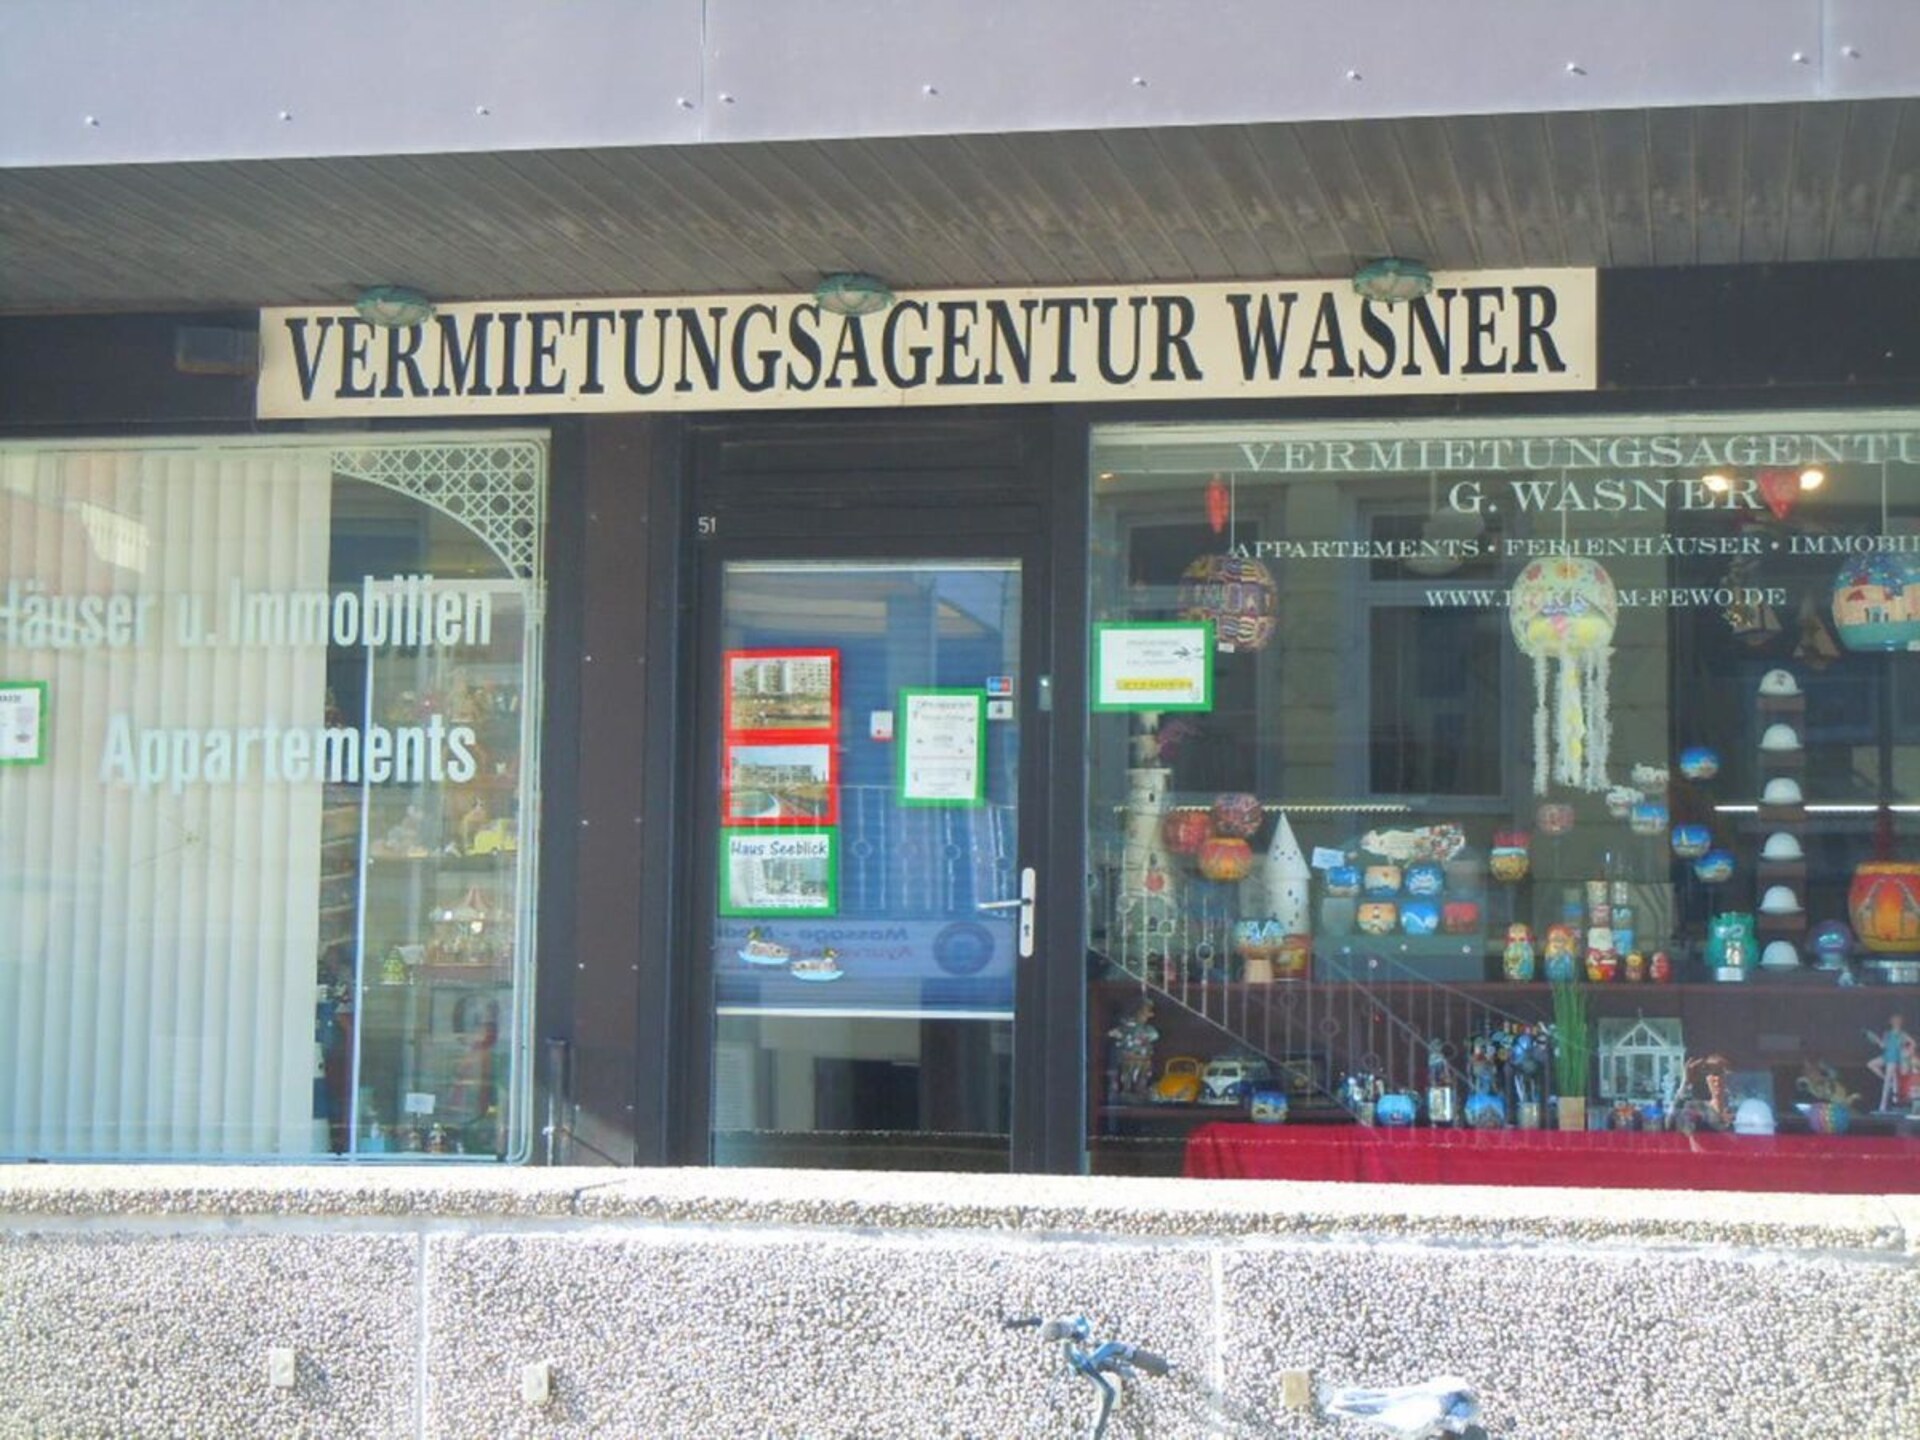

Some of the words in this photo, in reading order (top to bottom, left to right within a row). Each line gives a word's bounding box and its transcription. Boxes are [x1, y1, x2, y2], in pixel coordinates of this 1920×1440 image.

[284, 296, 1203, 400] VERMIETUNGSAGENTUR
[1226, 285, 1567, 381] WASNER
[1449, 480, 1498, 514] G.
[1510, 477, 1764, 512] WASNER
[698, 516, 717, 534] 51
[1234, 539, 1480, 559] APPARTEMENTS
[1504, 532, 1763, 556] FERIENHÄUSER
[103, 713, 477, 793] Appartements
[770, 840, 827, 856] Seeblick
